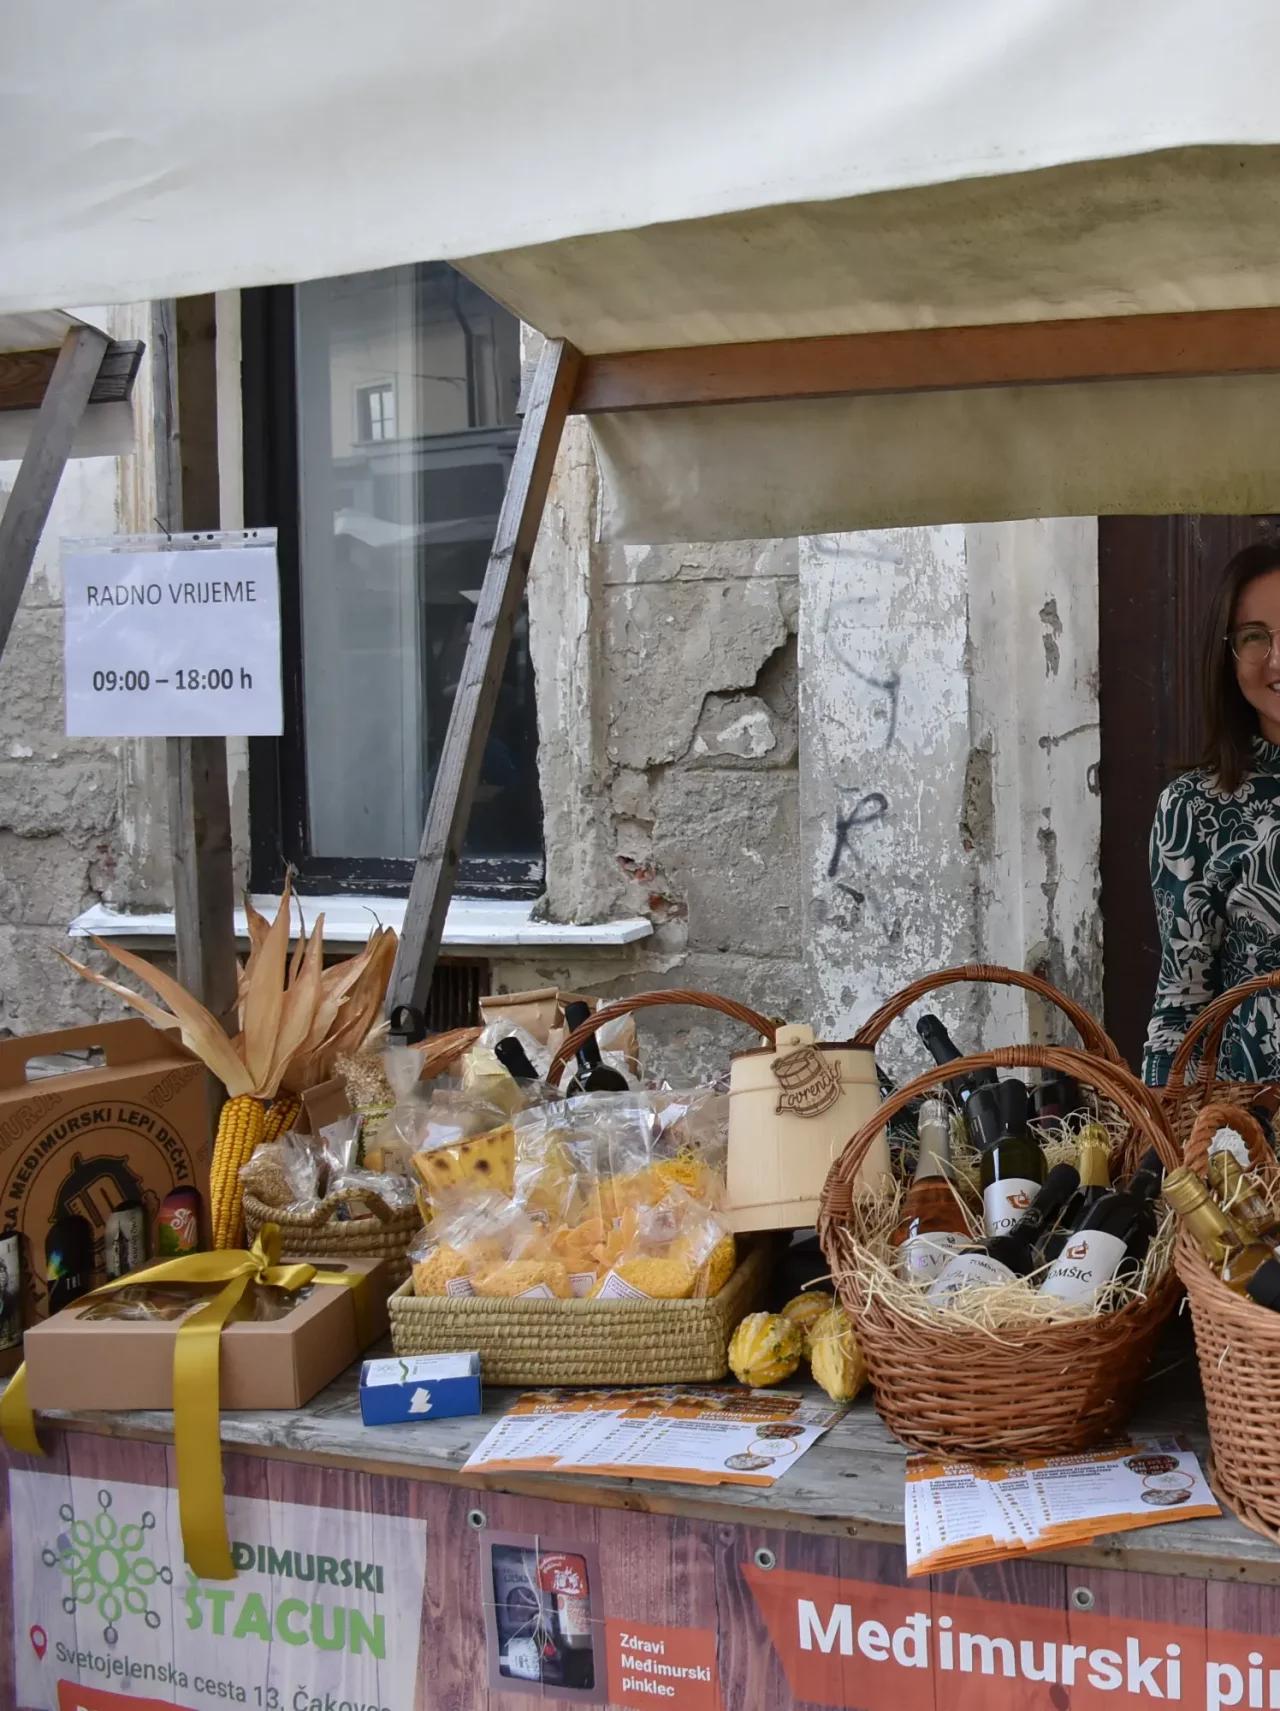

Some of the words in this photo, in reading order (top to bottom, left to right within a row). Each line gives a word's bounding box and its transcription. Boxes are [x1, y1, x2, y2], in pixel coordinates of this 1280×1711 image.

[87, 583, 163, 607] RADNO
[168, 580, 257, 604] VRIJEME
[92, 670, 150, 692] 09:00
[175, 668, 234, 691] 18:00
[240, 667, 252, 690] h
[117, 1107, 156, 1133] LEPI
[155, 1127, 190, 1182] DEČKI
[184, 1571, 387, 1660] ŠTACUN
[619, 1632, 665, 1655] Zdravi
[797, 1598, 1182, 1701] Međimurski
[55, 1642, 188, 1689] Svetojelenska
[194, 1672, 247, 1703] cesta
[620, 1653, 712, 1682] Međimurski
[622, 1676, 675, 1698] pinklec
